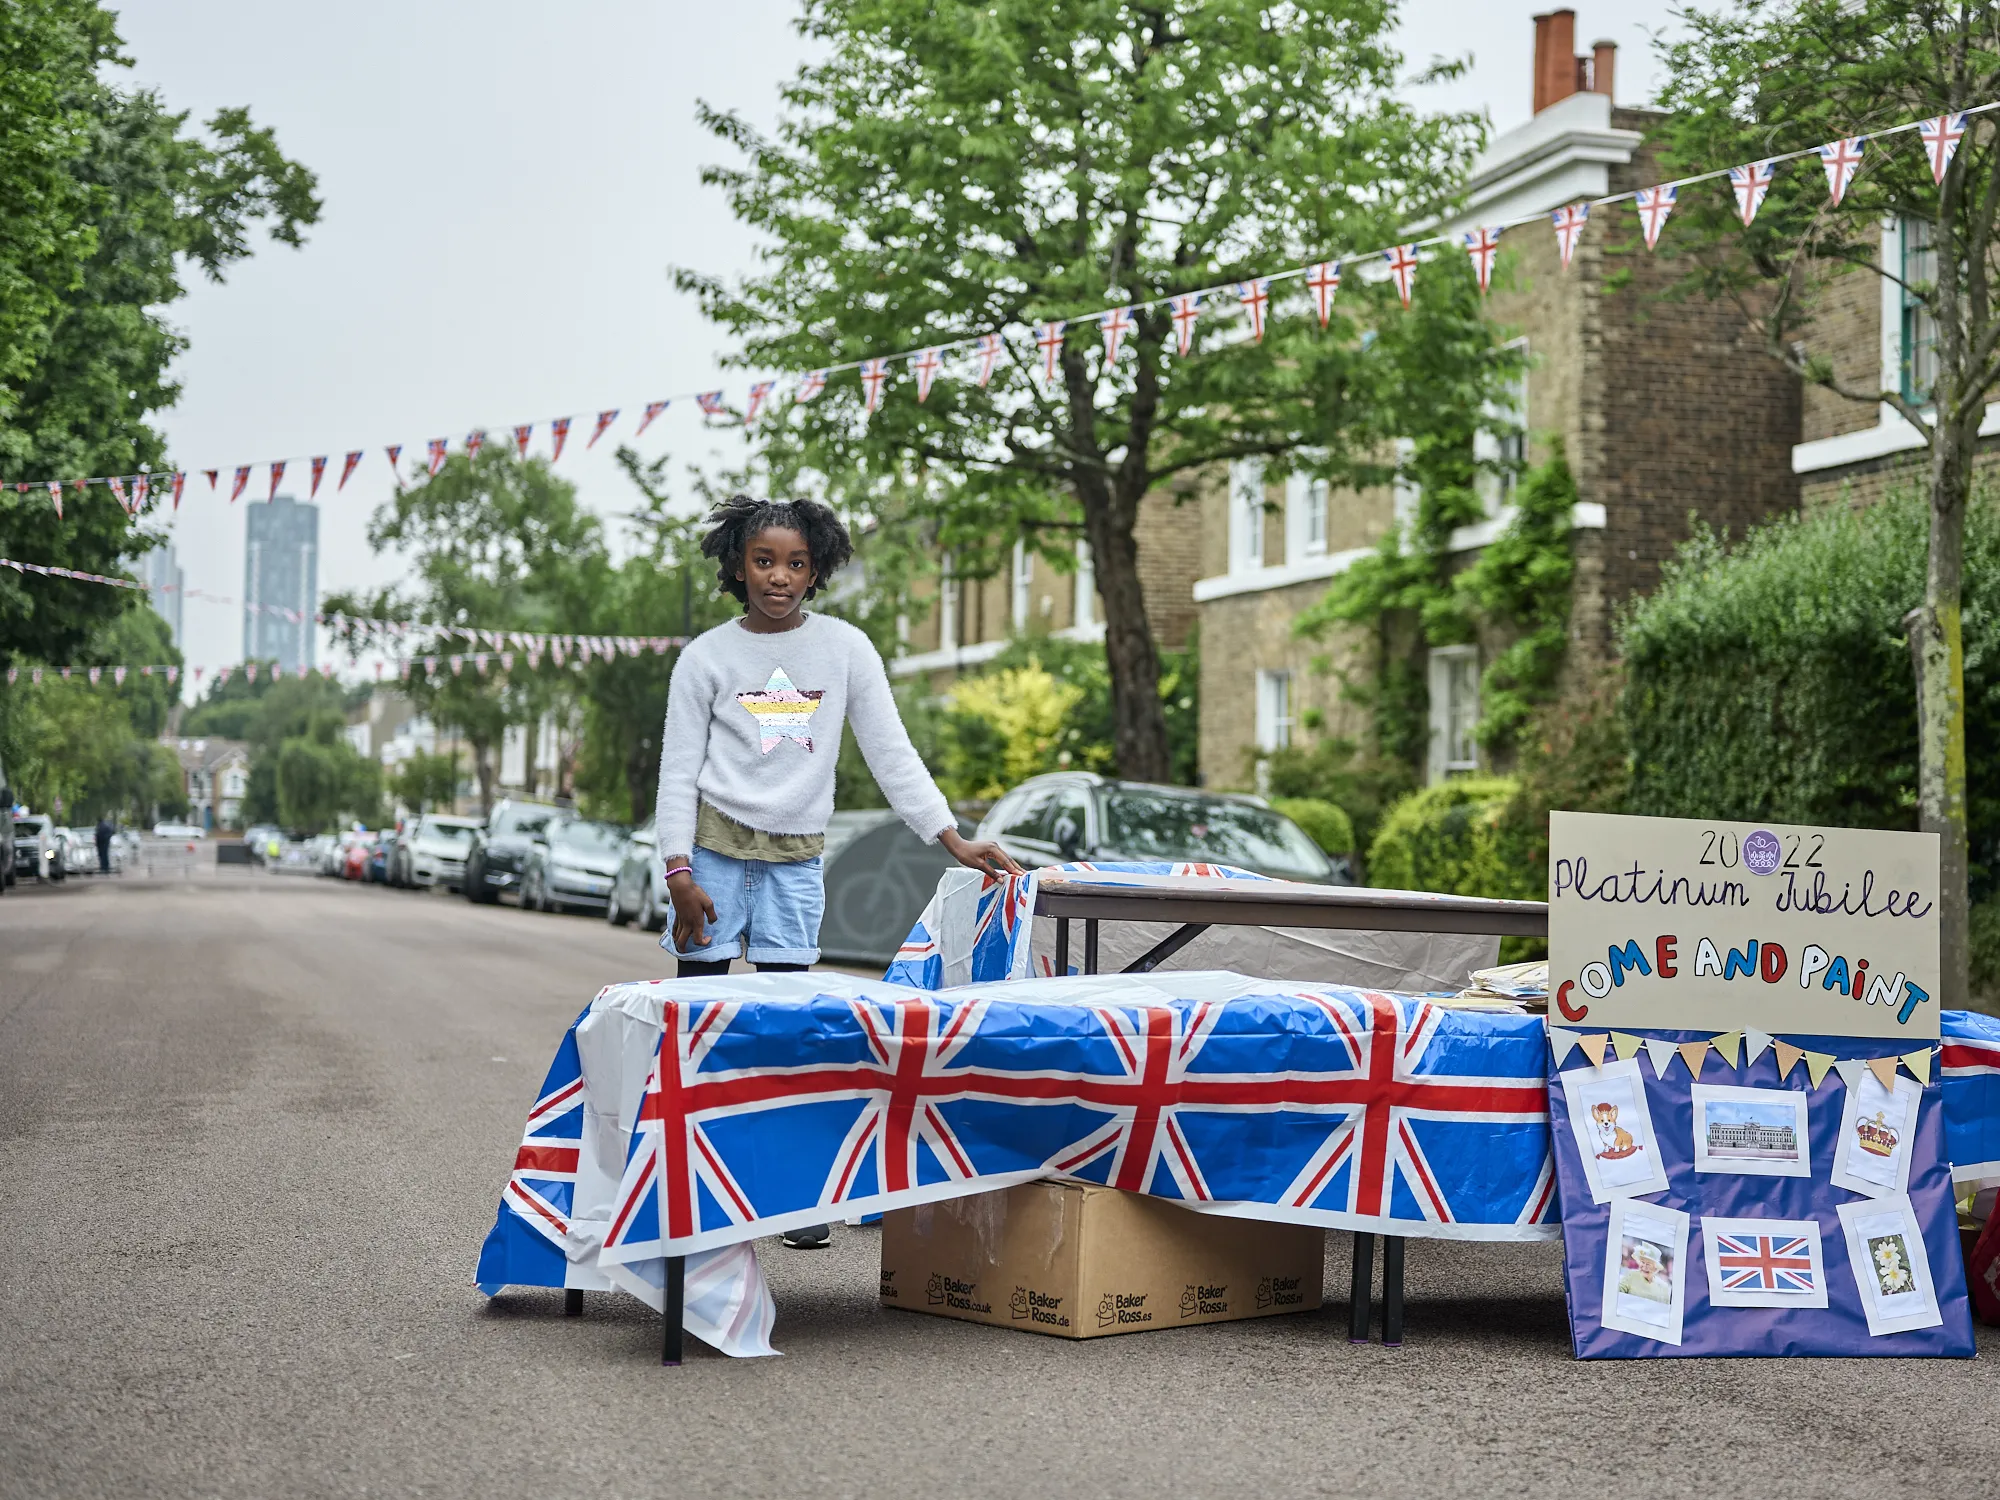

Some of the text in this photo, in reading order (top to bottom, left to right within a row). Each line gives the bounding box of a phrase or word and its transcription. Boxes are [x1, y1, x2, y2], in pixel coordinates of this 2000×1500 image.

[1699, 829, 1825, 869] 20 22
[1554, 856, 1933, 919] Platinum Jubilee
[1557, 935, 1678, 1022] COME
[1694, 937, 1788, 984] AND
[944, 1277, 974, 1295] Baker
[1197, 1285, 1226, 1300] Baker
[1272, 1276, 1299, 1292] Baker
[946, 1293, 992, 1314] Ross.co.uk
[1029, 1291, 1060, 1310] Baker
[1116, 1293, 1146, 1309] Baker
[1199, 1301, 1228, 1315] Ross.it
[1274, 1292, 1303, 1306] Ross.nl
[1031, 1309, 1070, 1327] Ross.de
[1117, 1309, 1152, 1325] Ross.es
